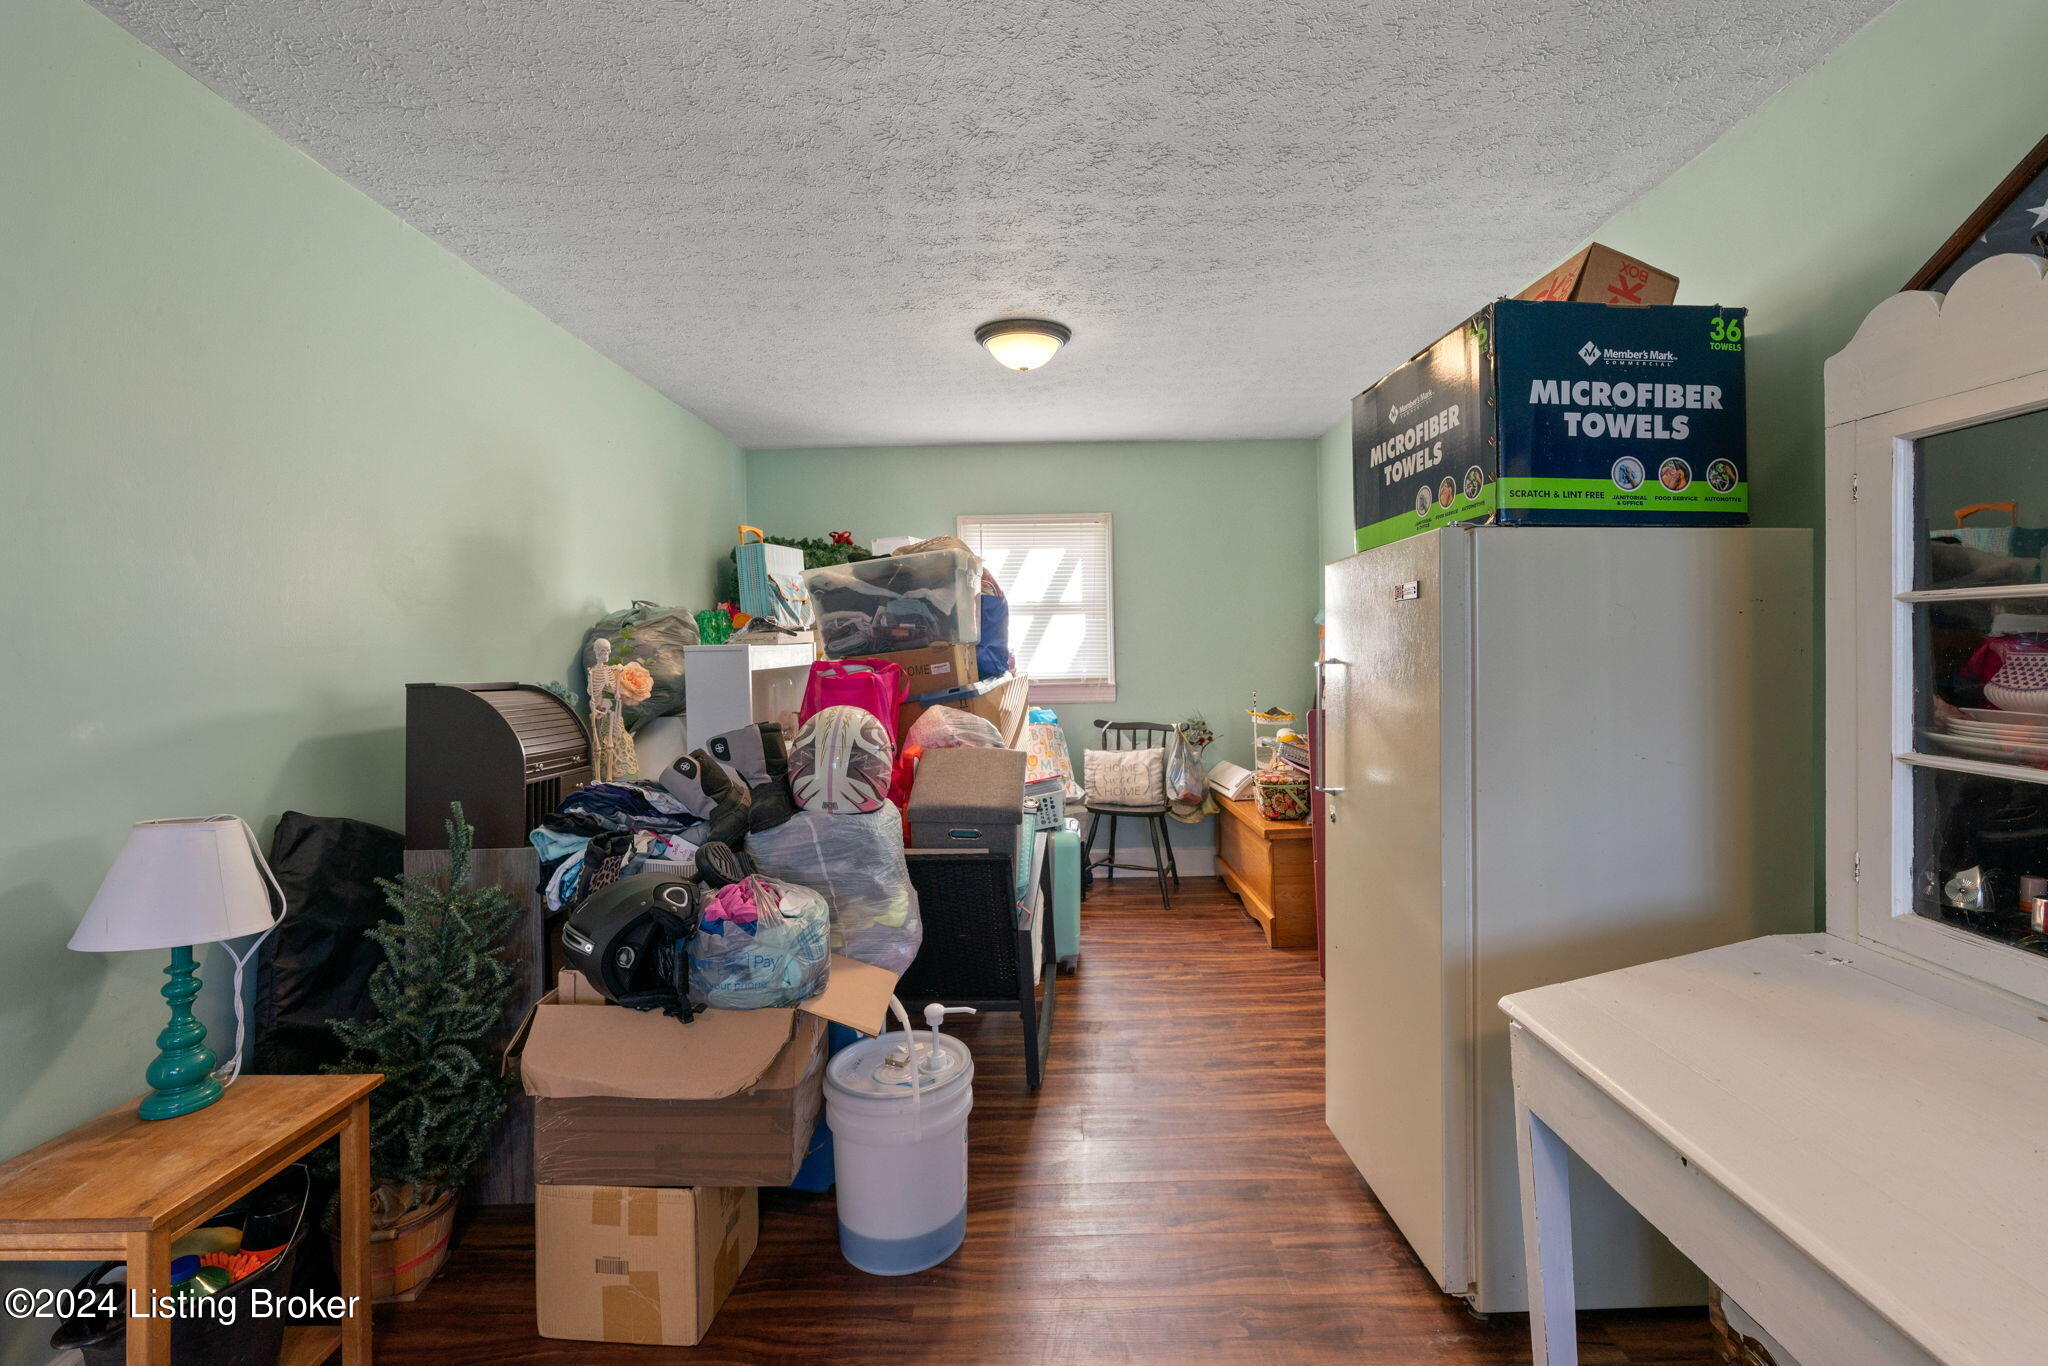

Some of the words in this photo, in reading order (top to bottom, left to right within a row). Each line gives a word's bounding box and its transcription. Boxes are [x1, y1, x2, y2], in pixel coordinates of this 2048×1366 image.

[1619, 261, 1649, 283] BOX
[1710, 317, 1741, 342] 36
[1603, 348, 1649, 359] Member's
[1649, 350, 1674, 360] Mark
[1710, 342, 1742, 352] TOWELS
[1529, 379, 1723, 410] MICROFIBER
[1369, 404, 1460, 468] MICROFIBER
[1564, 412, 1690, 440] TOWELS
[1384, 441, 1443, 486] TOWELS
[1509, 489, 1551, 499] SCRATCH
[1553, 490, 1560, 498] &
[1562, 490, 1583, 499] LINT
[1585, 491, 1605, 499] FREE
[1104, 763, 1139, 773] HOME
[1104, 786, 1141, 797] HOME
[754, 954, 779, 972] Pay
